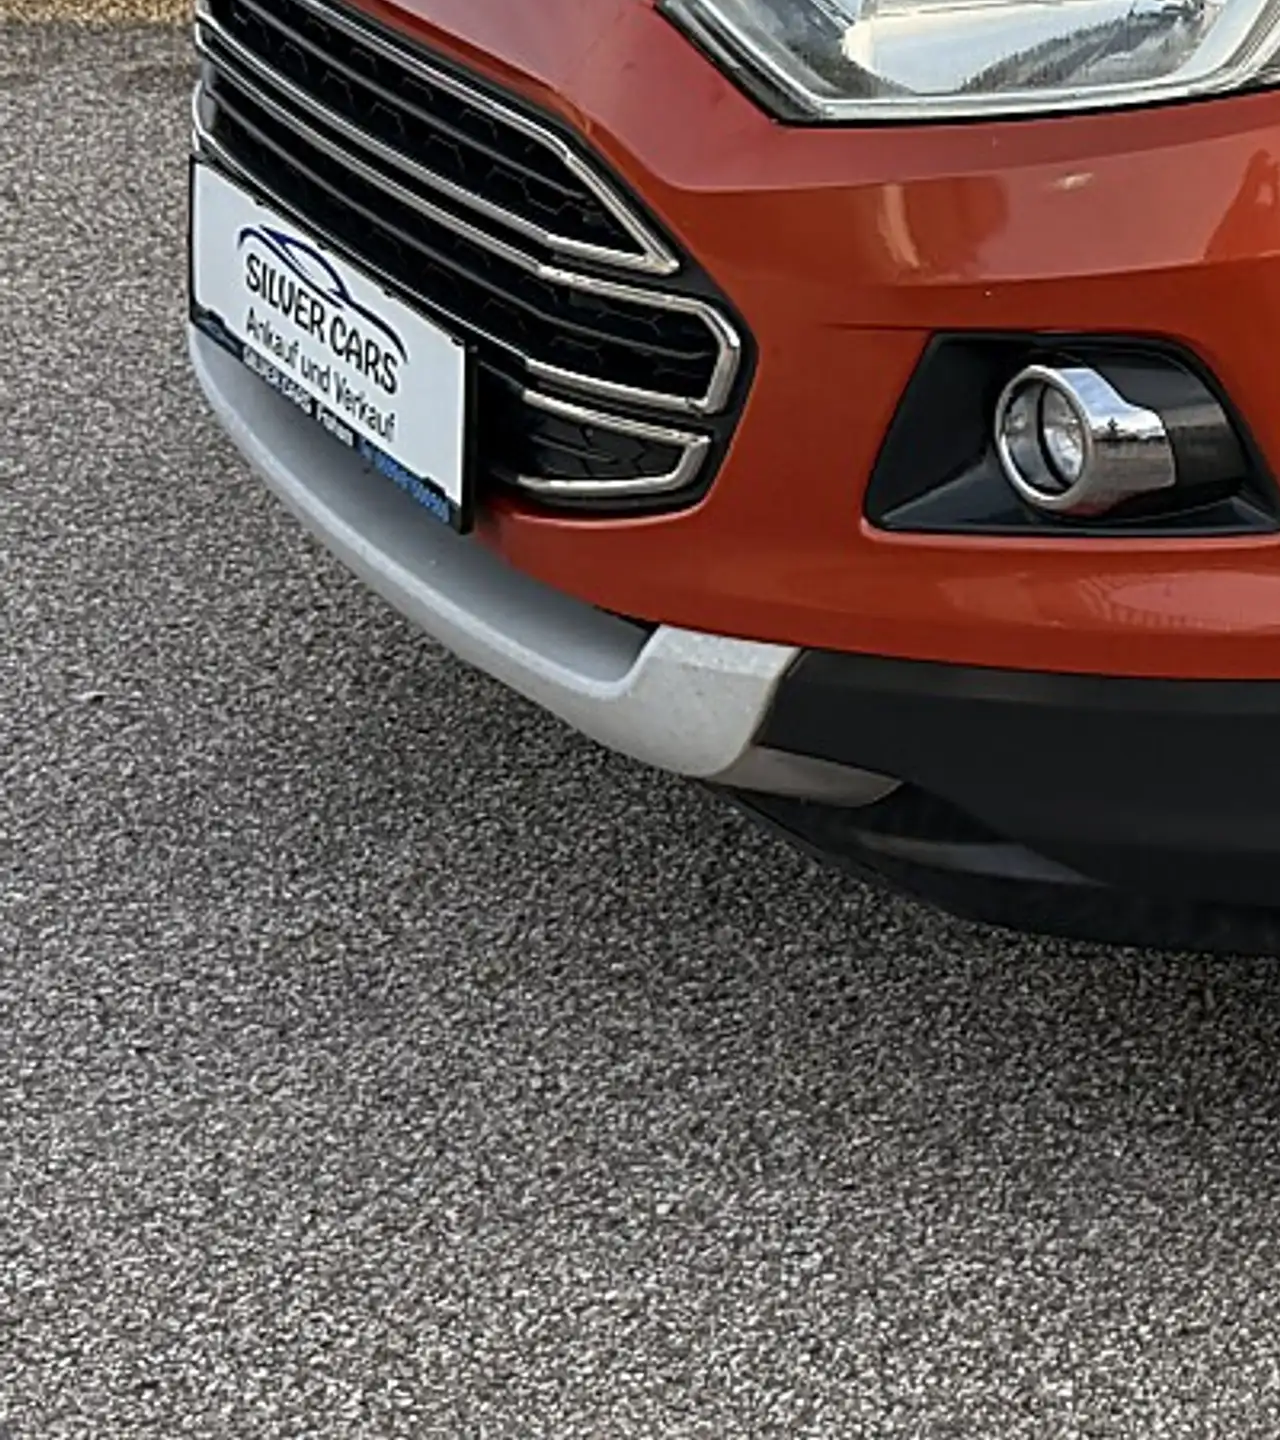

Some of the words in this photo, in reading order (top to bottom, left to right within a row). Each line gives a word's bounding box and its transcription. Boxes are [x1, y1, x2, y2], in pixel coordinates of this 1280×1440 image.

[245, 253, 326, 344] SILVER
[329, 315, 398, 396] CARS
[246, 306, 300, 370] Ankauf
[301, 351, 331, 394] und
[333, 370, 397, 444] Verkauf
